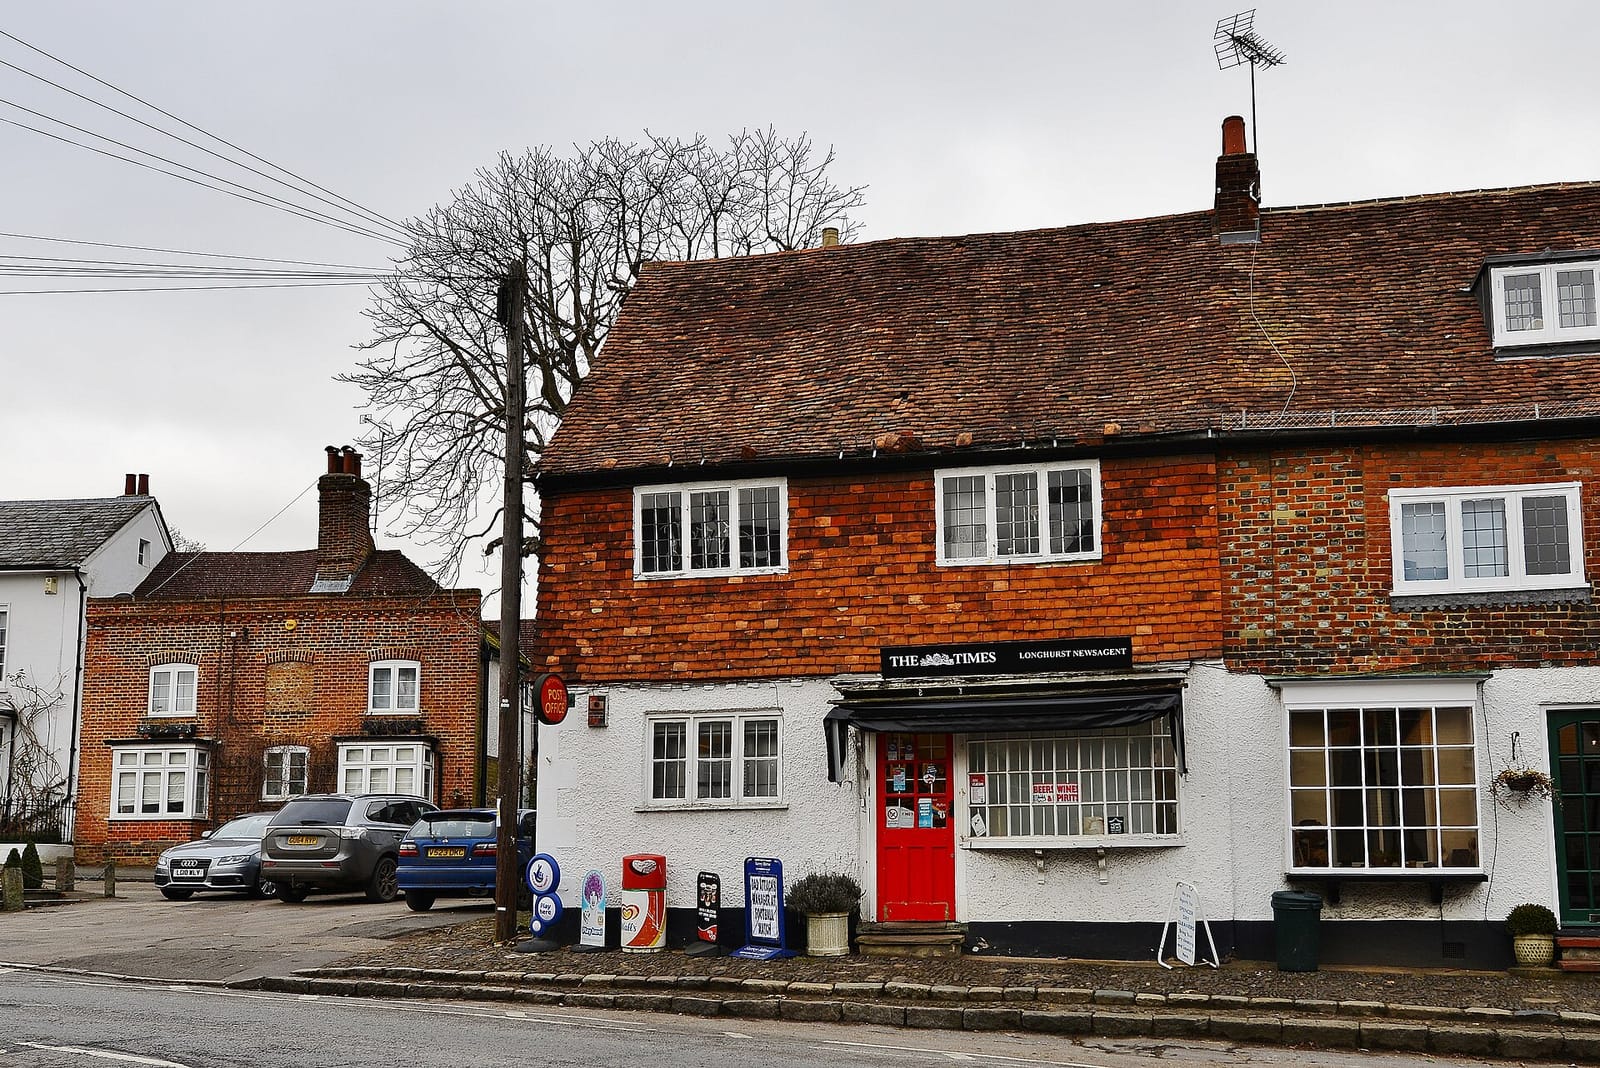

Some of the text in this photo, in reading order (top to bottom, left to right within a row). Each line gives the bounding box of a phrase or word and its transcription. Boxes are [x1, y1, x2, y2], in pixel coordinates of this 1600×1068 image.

[889, 651, 997, 667] THE TIMES
[1019, 647, 1127, 660] LONGHURST NEWSAGENT
[547, 689, 563, 700] POST
[545, 702, 565, 714] OFFICE
[1057, 785, 1078, 793] WINE
[1056, 794, 1078, 802] PIRIT
